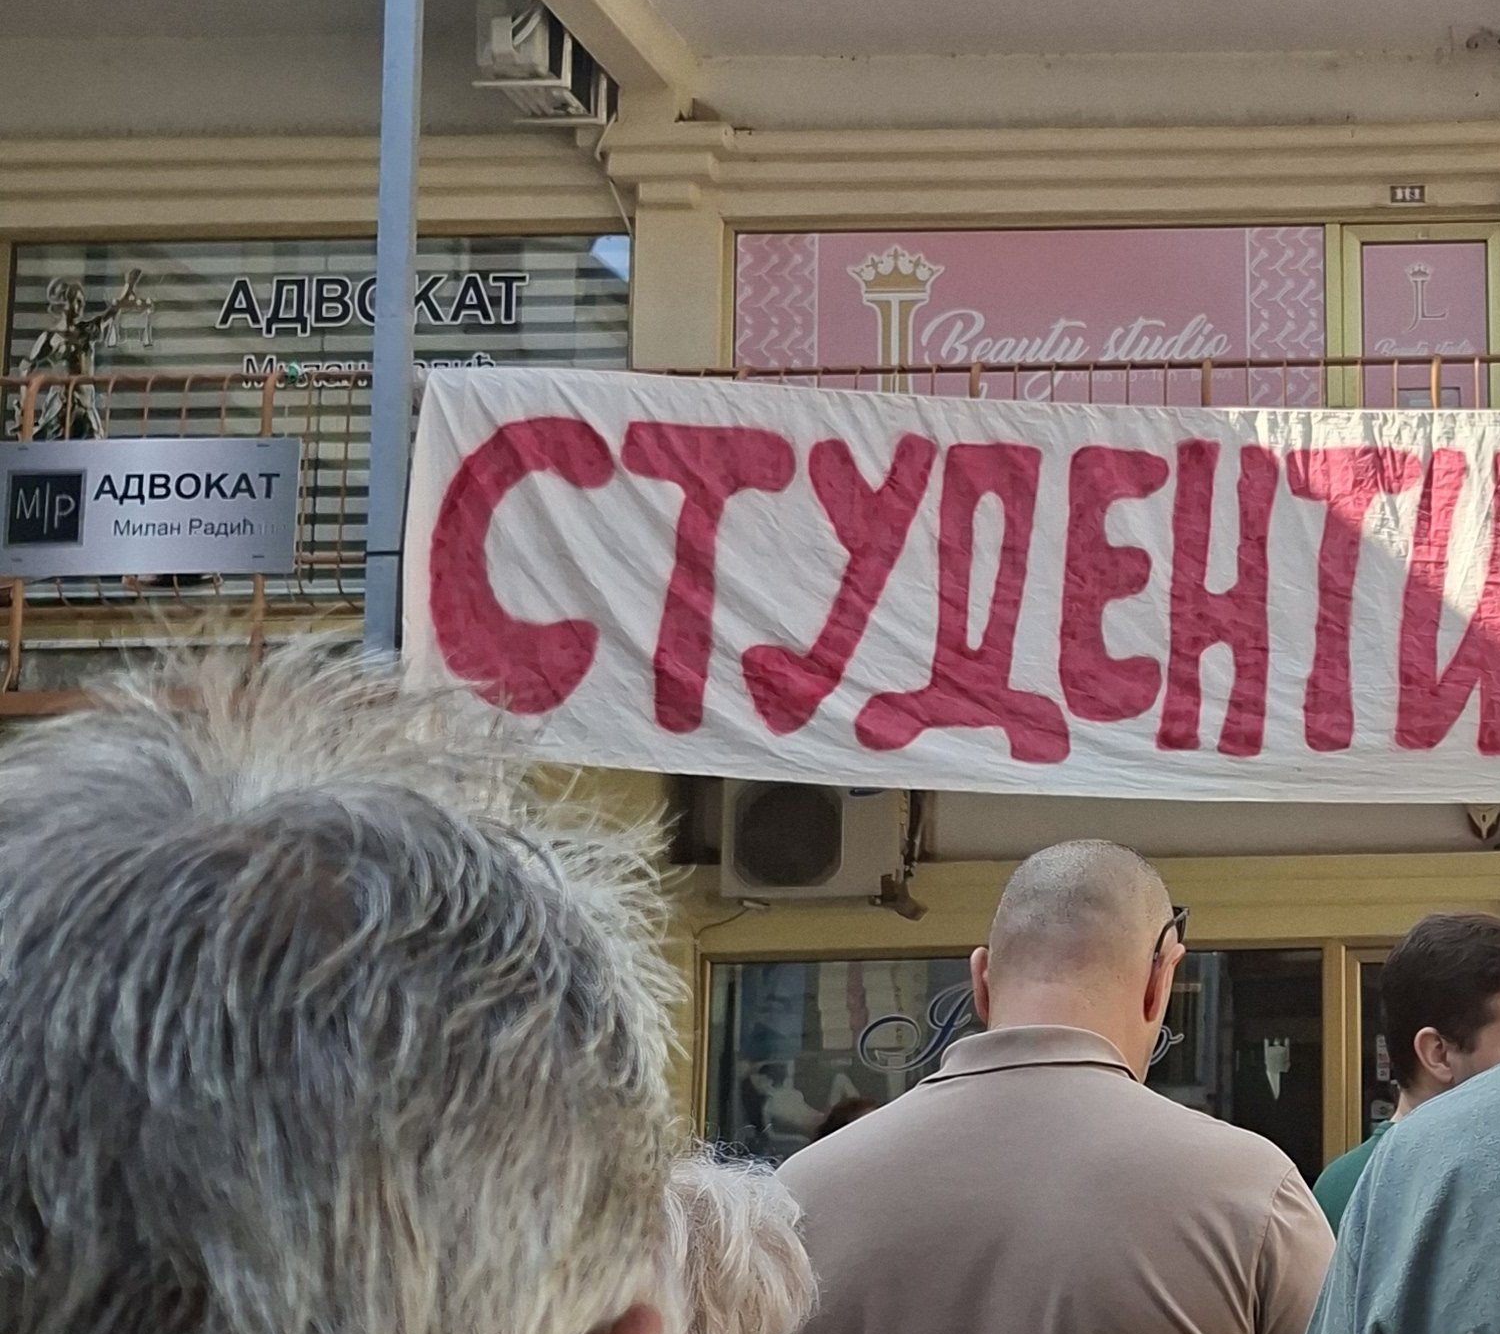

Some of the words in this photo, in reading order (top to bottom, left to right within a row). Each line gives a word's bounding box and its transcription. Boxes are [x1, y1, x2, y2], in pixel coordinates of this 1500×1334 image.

[921, 310, 1090, 402] Beauty
[1099, 313, 1232, 361] studio
[93, 472, 281, 506] АДВОКАТ
[113, 519, 181, 537] Милан
[188, 517, 254, 538] Радић
